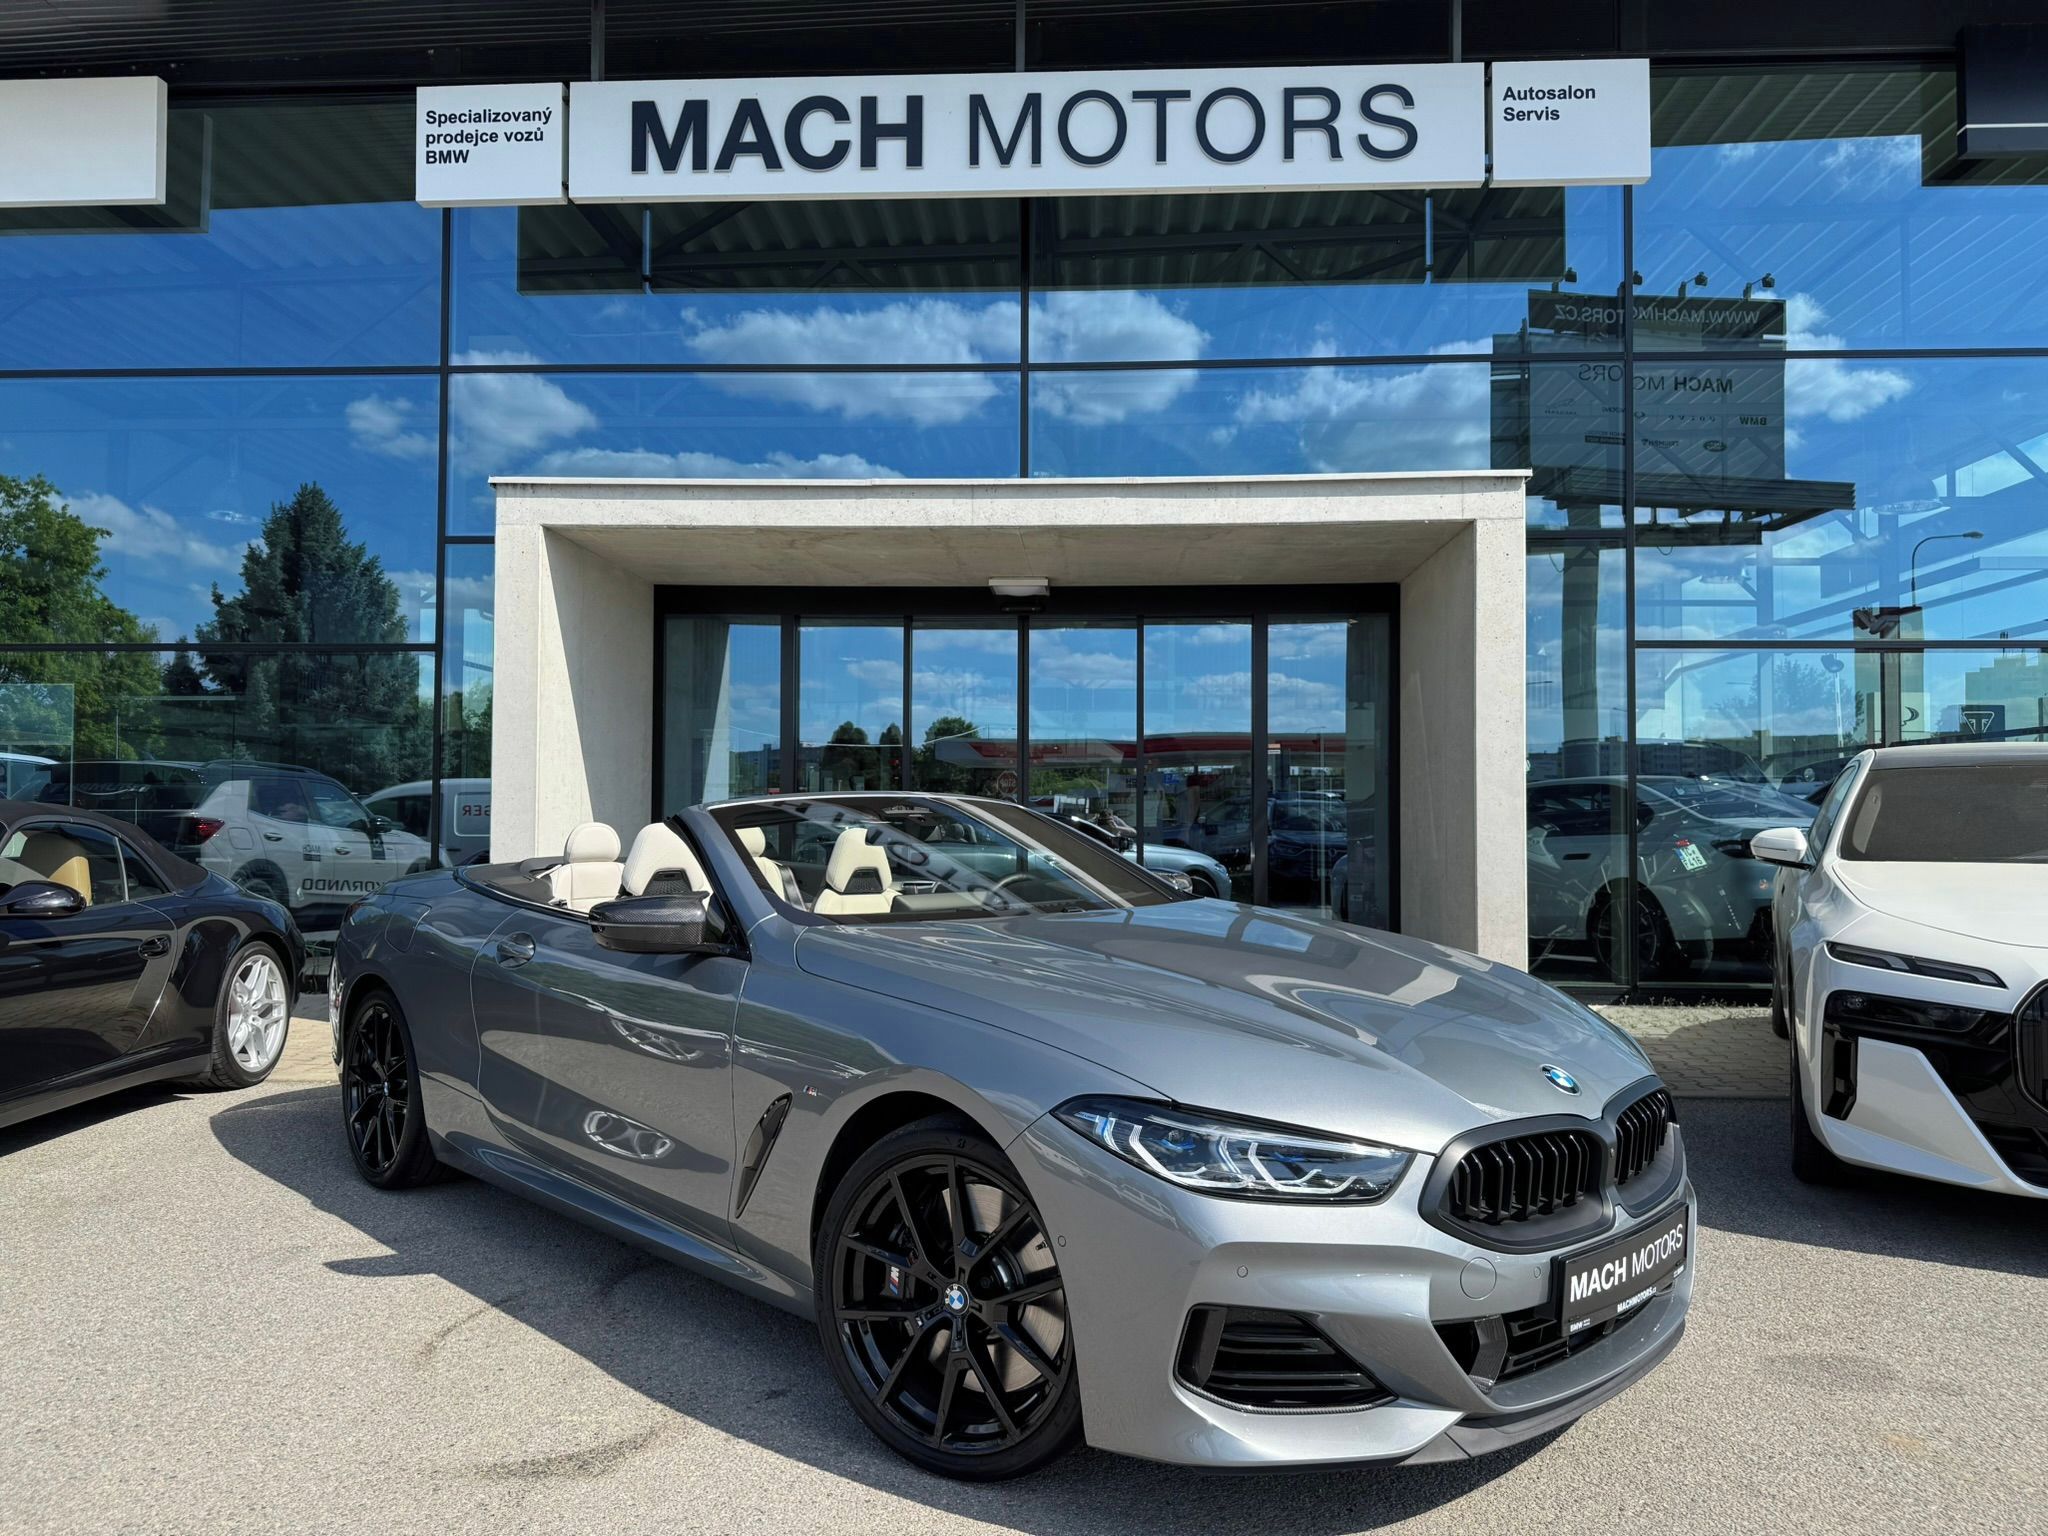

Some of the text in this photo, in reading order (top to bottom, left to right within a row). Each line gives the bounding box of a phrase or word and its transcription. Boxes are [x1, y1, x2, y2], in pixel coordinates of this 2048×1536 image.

[1502, 85, 1596, 101] Autosalon
[425, 107, 553, 128] Specializovaný
[1503, 106, 1561, 122] Servis
[425, 126, 544, 148] prodejce vozů
[631, 82, 1420, 174] MACH MOTORS
[425, 149, 470, 165] BMW
[1569, 1223, 1684, 1302] MACH MOTORS
